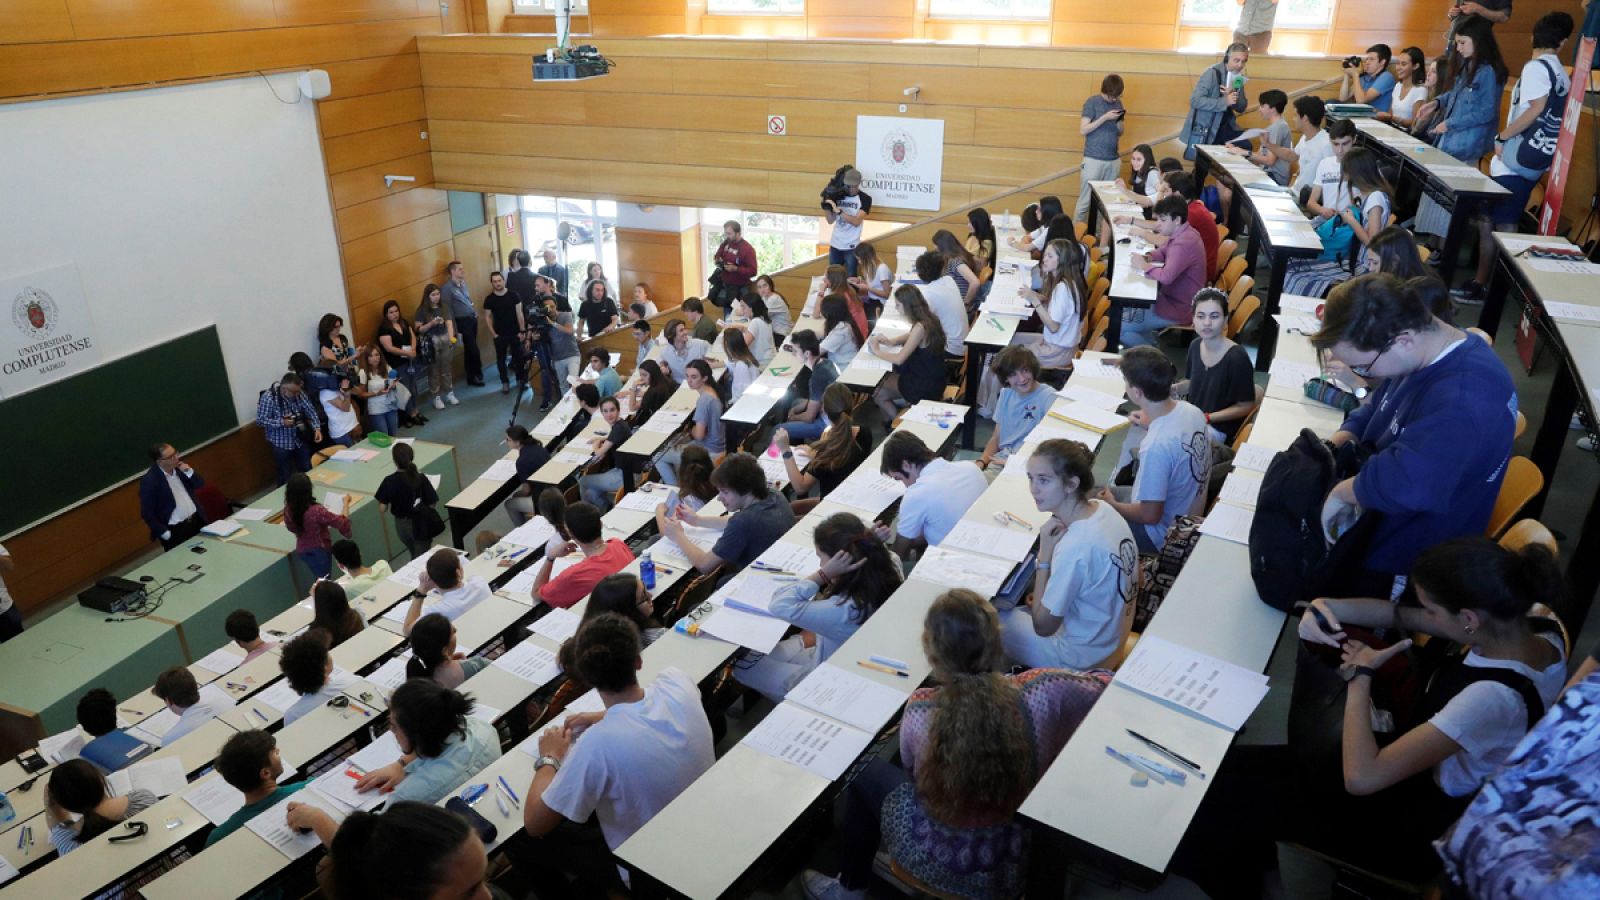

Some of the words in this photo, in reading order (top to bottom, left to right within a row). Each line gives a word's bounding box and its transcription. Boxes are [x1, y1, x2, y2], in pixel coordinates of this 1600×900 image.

[875, 172, 921, 181] UNIVERSIDAD
[860, 180, 936, 193] COMPLUTENSE
[18, 334, 72, 356] UNIVERSIDAD
[3, 337, 92, 375] COMPLUTENSE
[39, 361, 66, 374] MADRID
